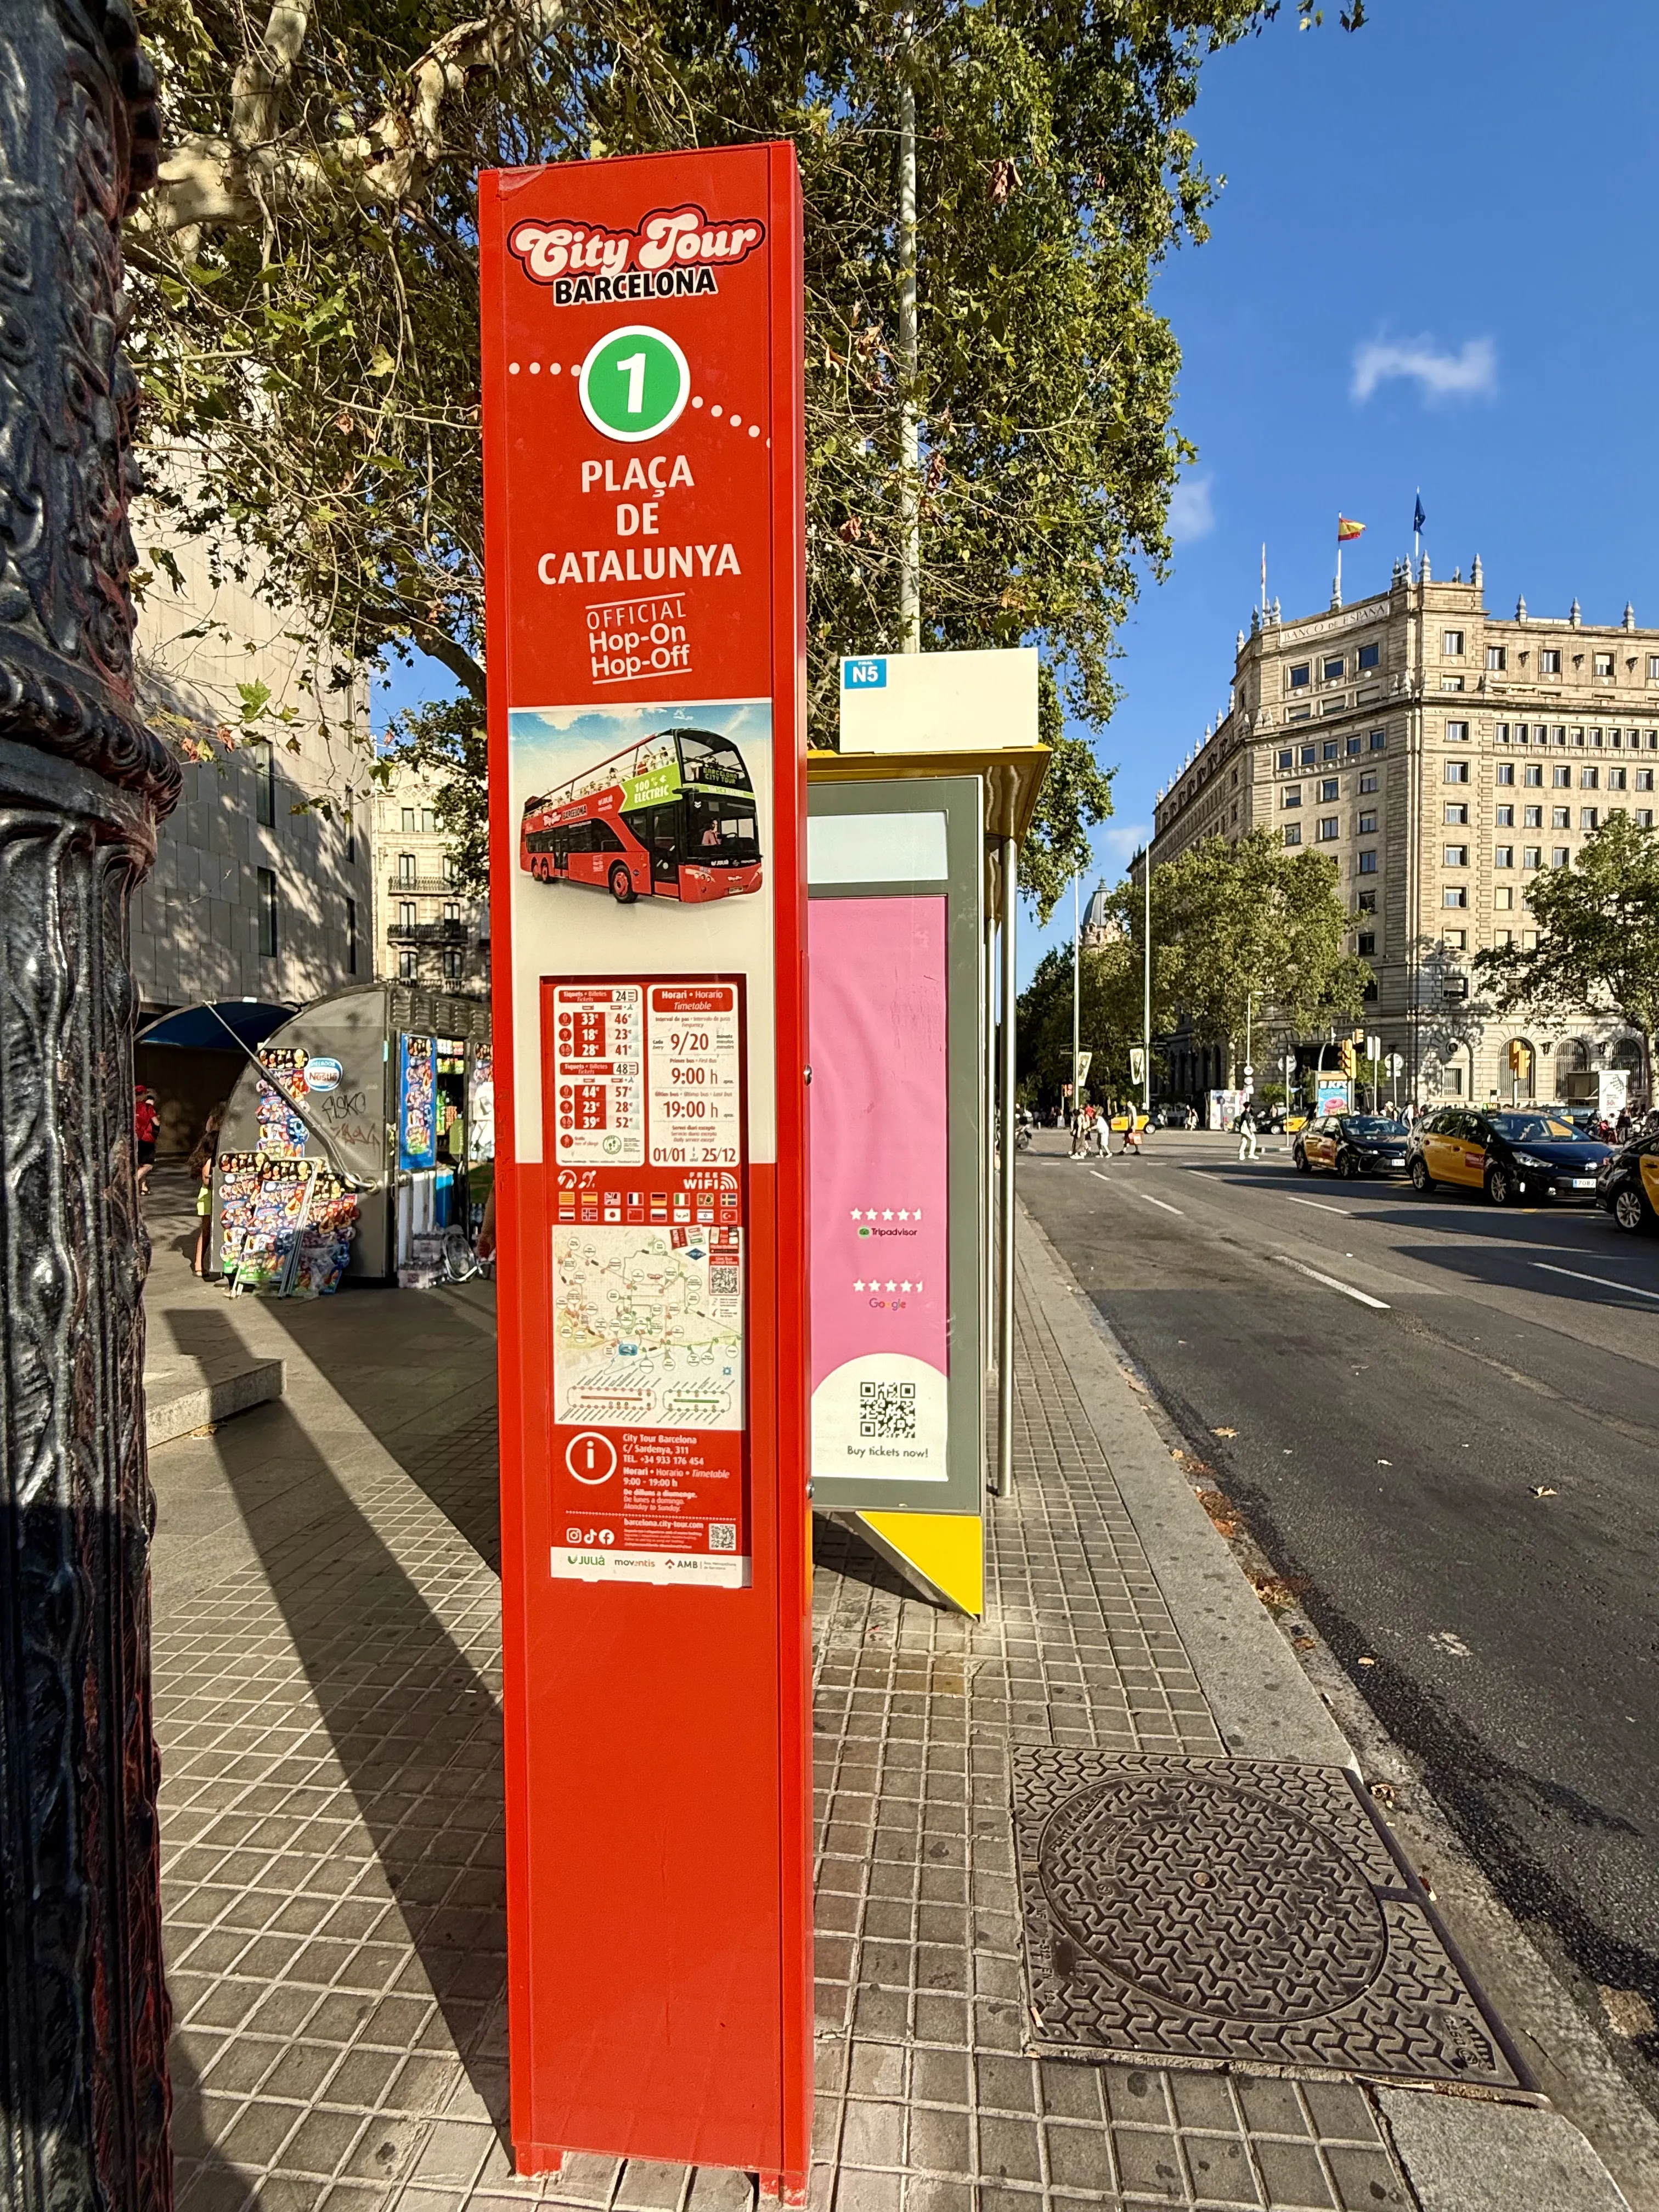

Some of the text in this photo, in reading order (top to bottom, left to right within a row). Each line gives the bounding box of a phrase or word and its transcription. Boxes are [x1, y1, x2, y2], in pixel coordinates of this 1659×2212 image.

[514, 213, 756, 277] City Tour
[554, 269, 716, 305] BARCELONA
[616, 353, 647, 413] 1
[582, 455, 695, 497] PLAÇA
[617, 502, 659, 535] DE
[538, 543, 742, 585] CATALUNYA
[586, 599, 686, 630] OFFICIAL
[589, 623, 686, 654] Hop-On
[1284, 623, 1324, 641] BANCO
[1328, 621, 1338, 629] DE
[591, 644, 690, 678] Hop-Off
[853, 665, 878, 682] N5
[634, 780, 650, 793] 100
[634, 785, 669, 804] ELECTRIC
[616, 991, 627, 1001] 24
[662, 990, 723, 999] Horari Horario
[674, 1001, 712, 1010] Timetable
[670, 1031, 709, 1056] 9/20
[616, 1064, 628, 1074] 48
[672, 1067, 705, 1085] 9:00
[710, 1069, 718, 1085] h
[663, 1101, 706, 1118] 19:00
[710, 1102, 718, 1118] h
[653, 1147, 685, 1163] 01/01
[702, 1147, 736, 1163] 25/12
[871, 1228, 918, 1237] Tripadvisor
[869, 1297, 907, 1311] Google
[623, 1434, 697, 1444] City Tour Barcelona
[675, 1446, 689, 1454] 311
[847, 1446, 928, 1458] Buy tickets now!
[640, 1455, 654, 1464] +34
[656, 1456, 670, 1464] 933
[673, 1457, 687, 1465] 176
[689, 1457, 704, 1465] 454
[623, 1467, 730, 1479] Horari Horario Timetable
[623, 1477, 641, 1486] 9:00
[648, 1479, 670, 1487] 19:00
[672, 1479, 678, 1487] h
[624, 1518, 704, 1529] barcelona.city-tour.com
[614, 1559, 656, 1567] moventis
[677, 1560, 698, 1568] AMB
